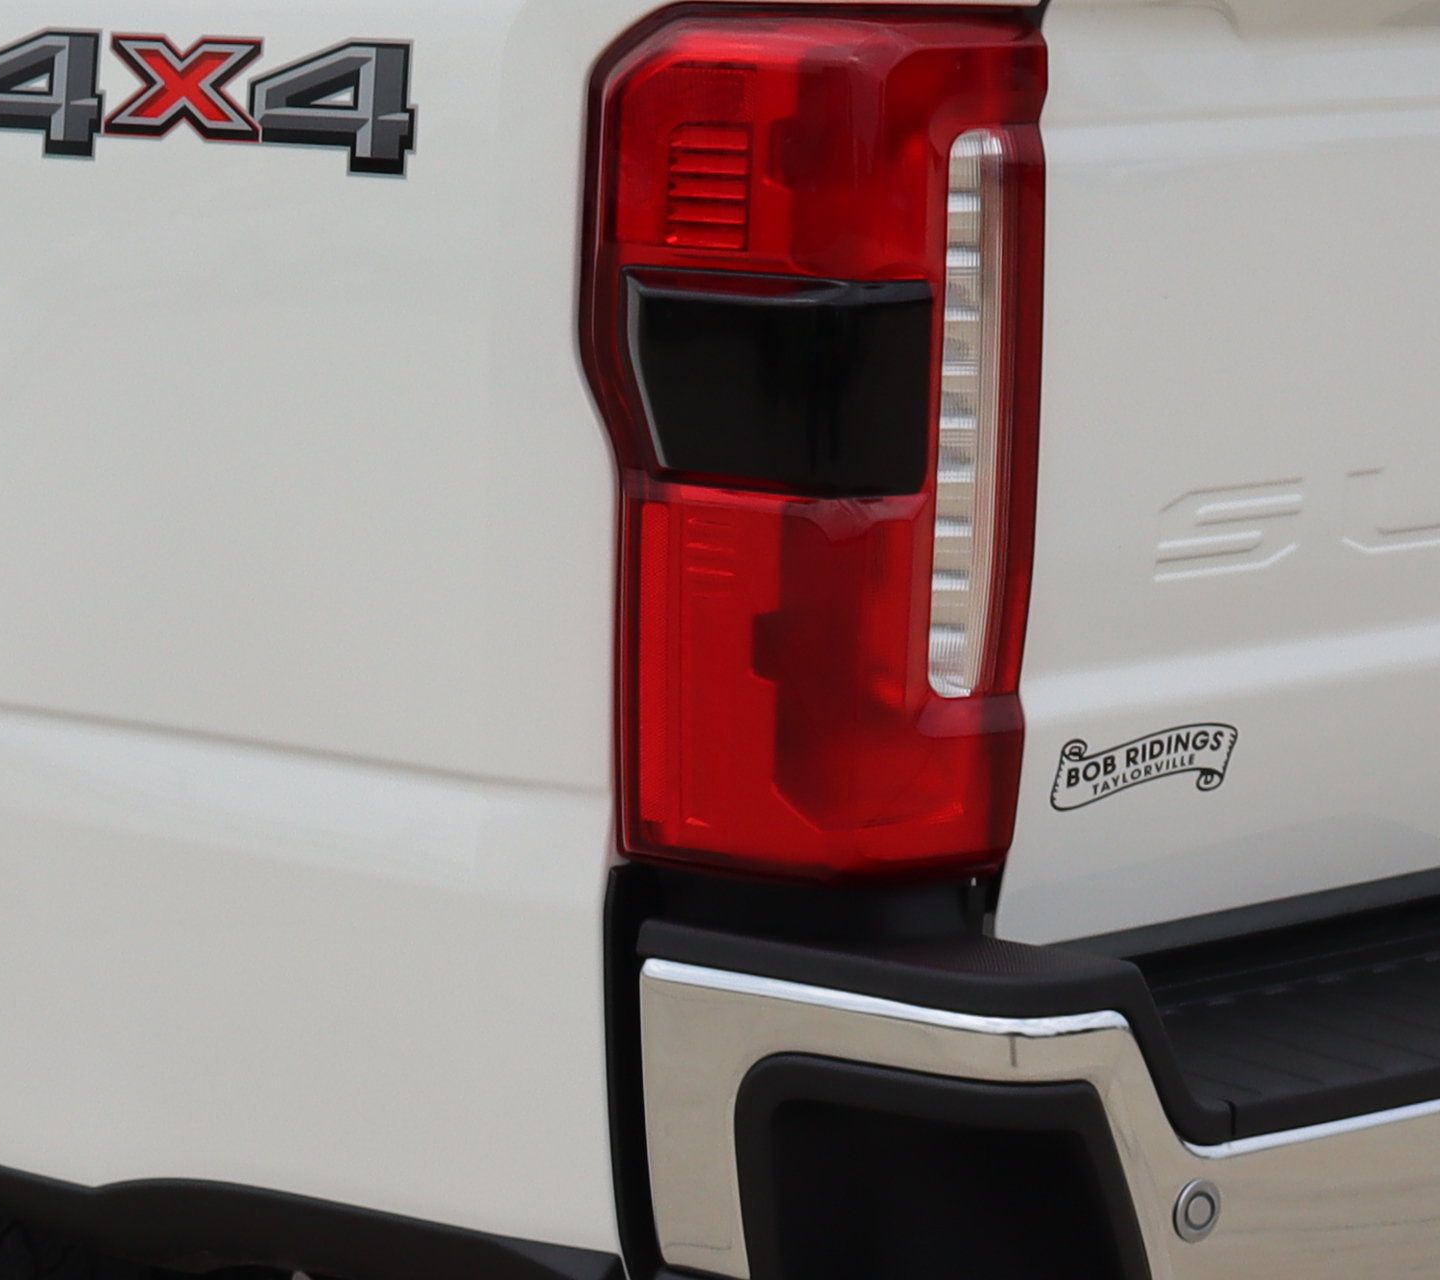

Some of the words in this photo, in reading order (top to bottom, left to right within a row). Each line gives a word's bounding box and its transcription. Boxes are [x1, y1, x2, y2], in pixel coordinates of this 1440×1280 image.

[1065, 754, 1117, 788] BOB
[1124, 730, 1225, 768] RIDINGS
[1091, 753, 1196, 796] TAYLORVILLE
